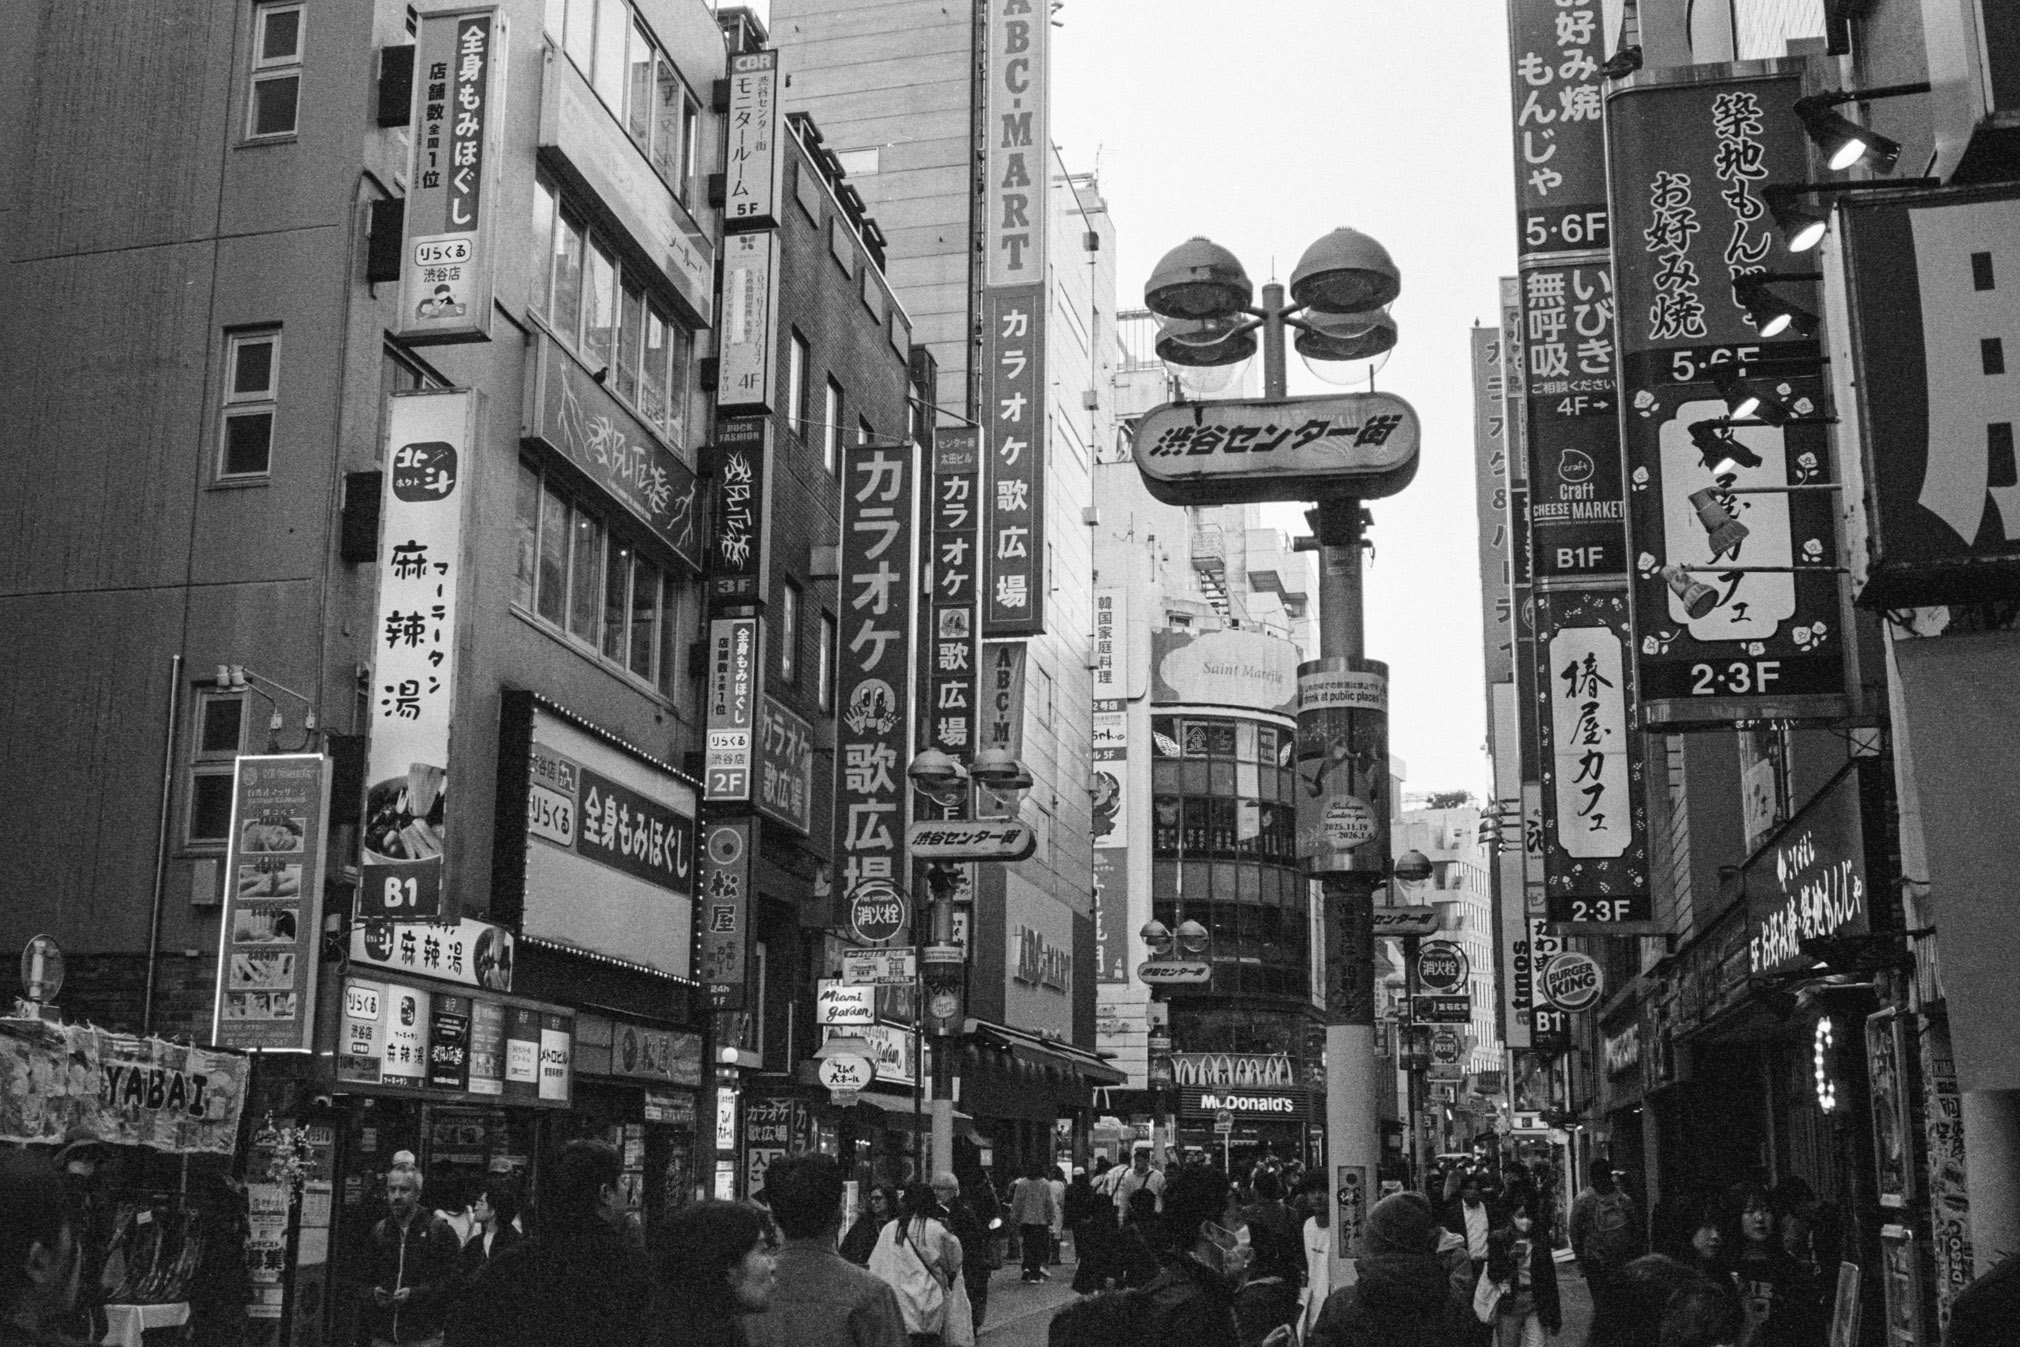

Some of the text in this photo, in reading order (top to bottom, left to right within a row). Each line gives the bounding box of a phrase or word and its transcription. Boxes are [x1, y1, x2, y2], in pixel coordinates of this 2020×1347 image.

[735, 55, 772, 71] CBR
[1555, 0, 1601, 121] 好み焼
[755, 76, 769, 151] 渋谷センター街
[1518, 52, 1562, 196] もんじゃ
[422, 62, 448, 190] 店舗数全国1位
[451, 25, 487, 226] 全身もみほぐし
[732, 77, 753, 197] モニタールーム
[737, 203, 758, 215] 5F
[1712, 92, 1771, 335] 築地もん
[420, 243, 468, 261] りらくる
[1644, 171, 1707, 339] お好み焼
[423, 266, 462, 283] 渋谷店
[1527, 272, 1570, 378] 無呼吸
[1573, 269, 1616, 374] いびき
[738, 373, 760, 389] 4F
[1531, 379, 1616, 394] ご相談ください
[1557, 396, 1588, 416] 4F
[719, 432, 760, 442] FASHION
[727, 423, 753, 433] ROCK
[1150, 414, 1403, 457] 渋谷センター街
[939, 437, 975, 448] センター街
[396, 447, 455, 493] 北斗
[1564, 460, 1589, 472] craft
[1559, 482, 1595, 500] Craft
[1533, 501, 1624, 519] CHEESE MARKET
[941, 476, 970, 596] カラオケ
[850, 451, 903, 673] カラオケ
[1557, 547, 1603, 568] B1F
[718, 579, 752, 593] 3F
[381, 540, 429, 720] 麻辣湯
[428, 562, 449, 693] マーラータン
[1098, 596, 1113, 684] 韓国家庭料理
[735, 628, 749, 724] 全身もみほぐし
[1203, 662, 1240, 676] Saint
[938, 642, 970, 746] 歌広場
[1330, 690, 1355, 703] public
[712, 736, 746, 746] りらくる
[762, 704, 810, 765] カラオケ
[1561, 652, 1615, 832] 椿屋カフェ
[711, 753, 745, 765] 渋谷店
[1103, 752, 1114, 760] 5F
[714, 773, 742, 792] 2F
[533, 795, 569, 834] りらくる
[843, 742, 898, 899] 歌広場
[584, 786, 688, 878] 全身もみほぐし
[912, 829, 1022, 845] 渋谷センター街
[1324, 823, 1368, 831] 2025.11.19
[384, 877, 418, 908] B1
[708, 870, 739, 933] 松屋
[857, 905, 899, 925] 消火栓
[401, 930, 463, 975] 麻辣湯
[1423, 961, 1457, 976] 消火栓
[1549, 963, 1594, 984] BURGER
[710, 985, 730, 994] 24h
[1512, 940, 1531, 1026] atmos
[1551, 972, 1597, 1000] KING
[350, 993, 377, 1014] りらくる
[713, 996, 726, 1005] 1F
[819, 990, 863, 1003] Miami
[826, 1005, 873, 1022] garden
[1536, 1010, 1566, 1032] B1
[351, 1023, 373, 1041] 渋谷店
[387, 1043, 424, 1066] 麻辣湯
[830, 1073, 860, 1083] 大ホール
[835, 1064, 856, 1073] てんぐ
[104, 1065, 208, 1117] YABAI
[748, 1105, 789, 1122] カラオケ
[748, 1125, 788, 1142] 歌広場
